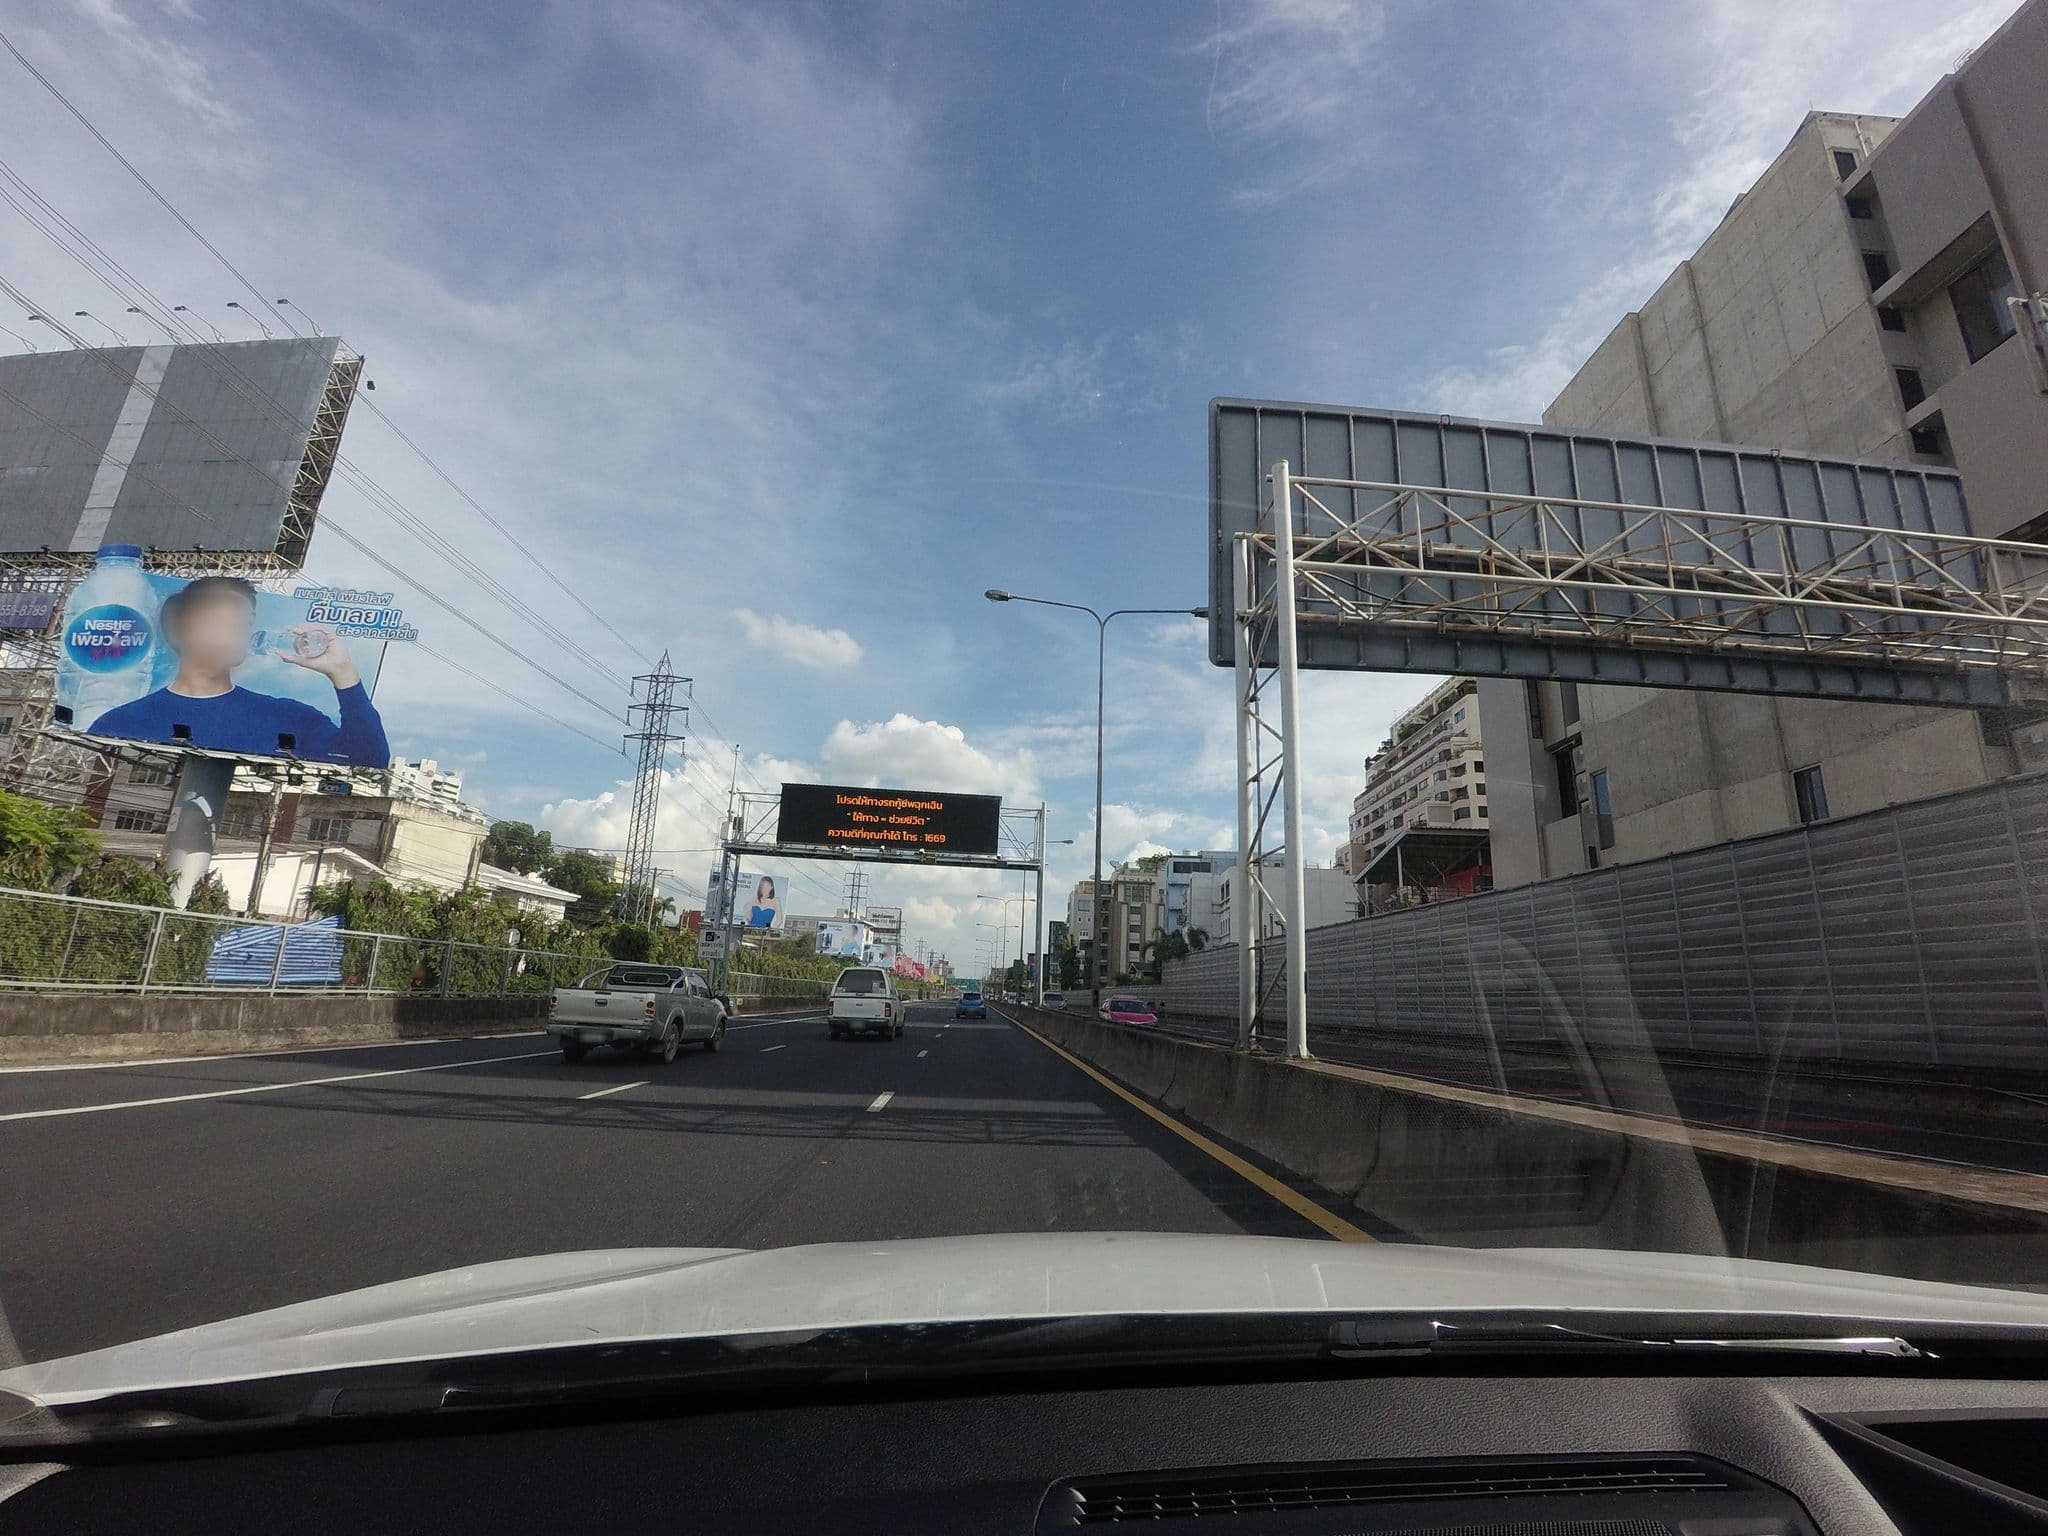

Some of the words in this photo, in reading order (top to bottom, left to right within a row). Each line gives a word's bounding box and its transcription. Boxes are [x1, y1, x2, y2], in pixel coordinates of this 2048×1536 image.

[309, 601, 378, 625] ดื่มเลย
[337, 623, 418, 640] สะอาดสดชื่น
[924, 833, 946, 843] 1669
